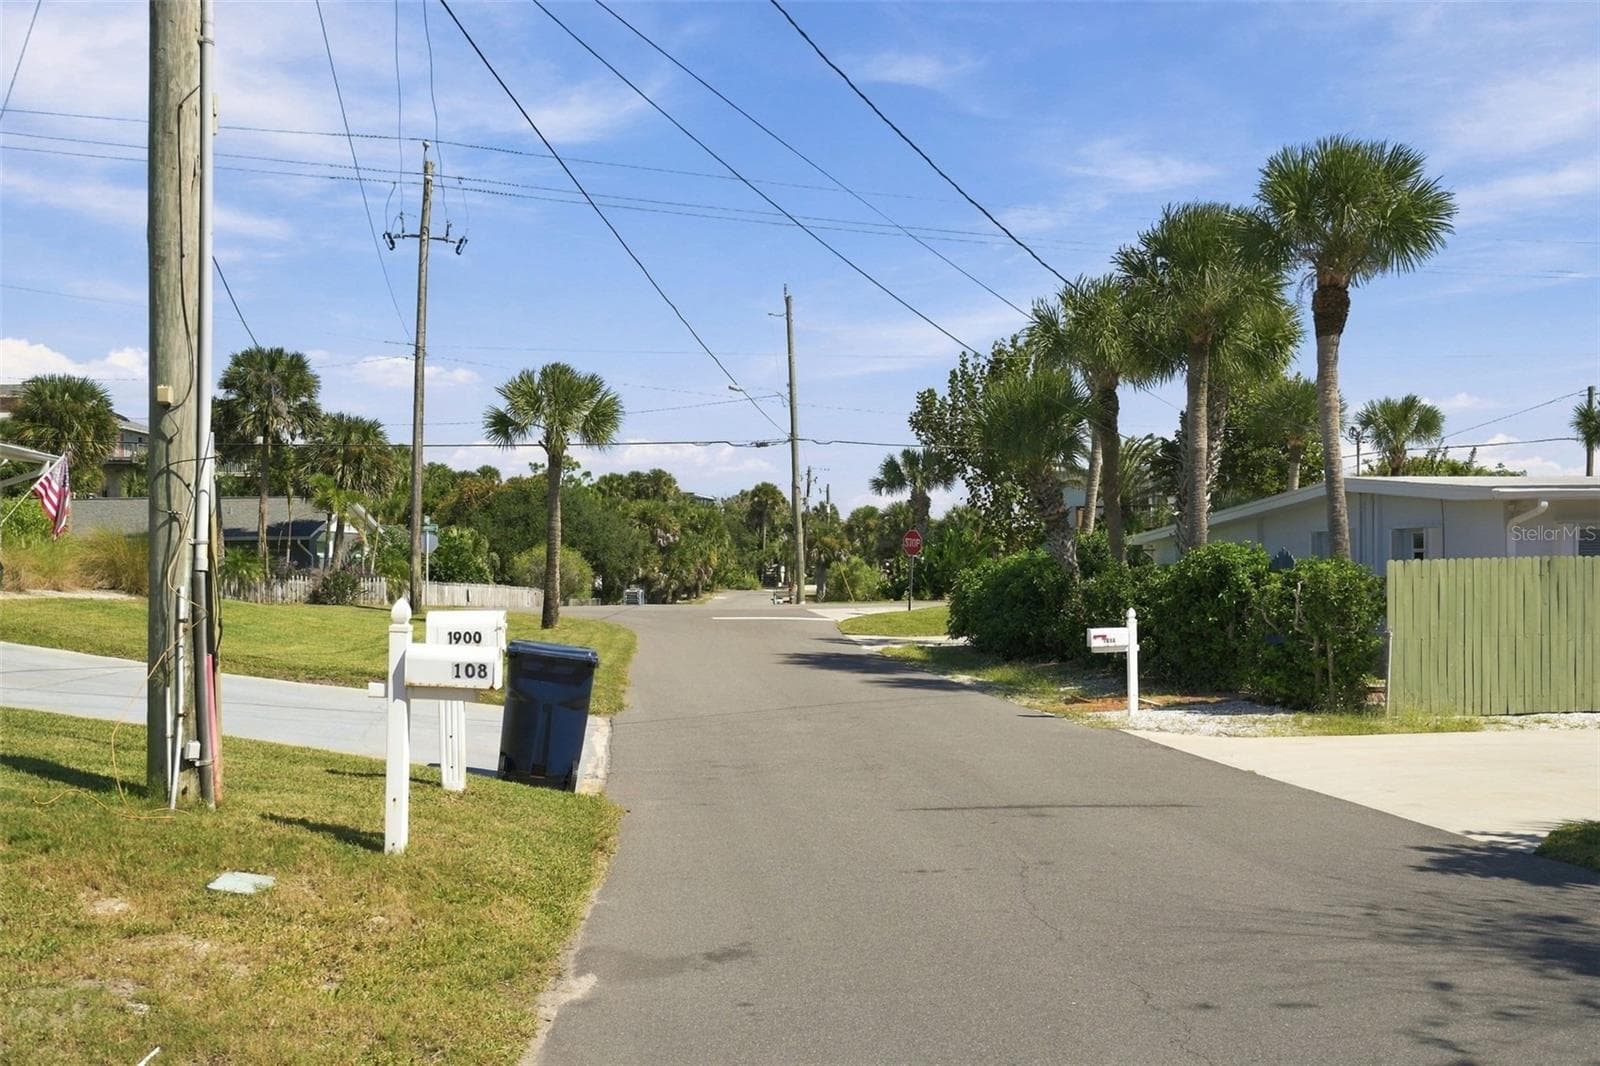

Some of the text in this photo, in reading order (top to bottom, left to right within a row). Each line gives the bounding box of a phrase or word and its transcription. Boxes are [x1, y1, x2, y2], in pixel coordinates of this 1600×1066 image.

[905, 537, 921, 548] STOP
[447, 631, 482, 645] 1900
[454, 663, 488, 679] 108
